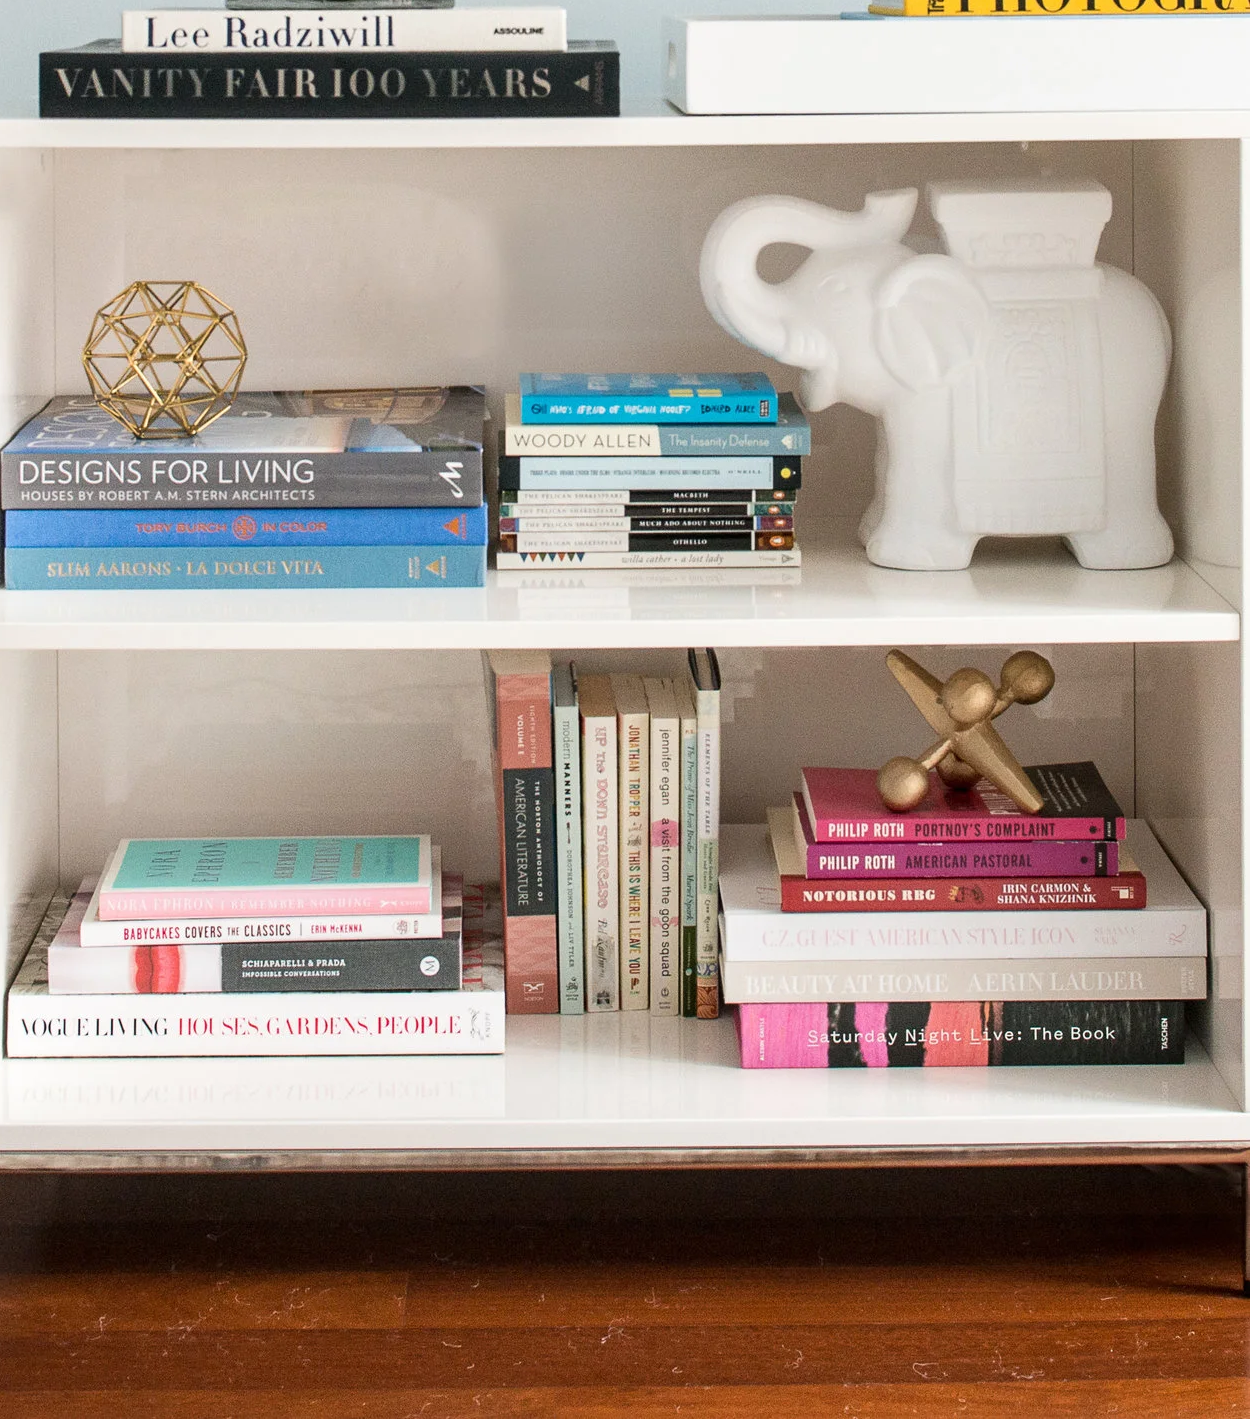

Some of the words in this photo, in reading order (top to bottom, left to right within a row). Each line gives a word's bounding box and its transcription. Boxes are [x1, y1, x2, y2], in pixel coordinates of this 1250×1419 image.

[146, 15, 210, 48] Lee
[223, 14, 396, 48] Radziwill
[493, 27, 545, 35] ASSOULINE
[54, 66, 212, 100] VANITY
[223, 67, 319, 99] FAIR
[419, 66, 552, 99] YEARS
[514, 433, 587, 448] WOODY
[593, 433, 651, 448] ALLEN
[669, 434, 688, 447] The
[691, 433, 727, 449] Insanity
[729, 434, 770, 447] Defense
[19, 459, 142, 484] DESIGNS
[152, 459, 208, 484] FOR
[218, 459, 315, 484] LIVING
[20, 490, 74, 502] HOUSES
[78, 490, 94, 501] BY
[99, 490, 150, 501] ROBERT
[155, 490, 182, 501] A.M.
[187, 490, 228, 501] STERN
[232, 489, 316, 501] ARCHITECTS
[673, 491, 709, 499] MACBETH
[135, 522, 172, 534] TORY
[176, 522, 227, 533] BURCH
[261, 521, 277, 532] IN
[278, 521, 328, 532] COLOR
[681, 519, 707, 527] ABOUT
[672, 538, 707, 546] OTHELLO
[621, 554, 643, 564] willa
[646, 554, 672, 564] cather
[689, 553, 703, 563] lost
[705, 554, 724, 565] lady
[47, 562, 90, 577] SLIM
[96, 561, 172, 576] AARONS
[186, 561, 208, 575] LA
[214, 561, 276, 575] DOLCE
[281, 560, 325, 574] VITA
[562, 721, 573, 760] modern
[628, 724, 641, 772] JONATHAN
[659, 728, 672, 773] jennifer
[564, 762, 572, 817] MANNERS
[704, 777, 711, 788] OF
[628, 778, 641, 818] TROPPER
[659, 777, 671, 806] egan
[514, 778, 527, 838] AMERICAN
[661, 817, 670, 826] a
[828, 822, 869, 838] PHILIP
[873, 822, 905, 838] ROTH
[914, 822, 983, 838] PORTNOY'S
[986, 822, 1056, 837] COMPLAINT
[661, 829, 671, 852] visit
[535, 837, 543, 888] ANTHOLOGY
[628, 850, 641, 872] THIS
[661, 856, 671, 882] from
[819, 856, 860, 870] PHILIP
[864, 855, 896, 869] ROTH
[905, 854, 968, 869] AMERICAN
[973, 854, 1033, 868] PASTORAL
[515, 842, 529, 906] LITERATURE
[628, 874, 641, 883] IS
[686, 874, 694, 897] Muriel
[1002, 883, 1028, 894] IRIN
[1030, 883, 1080, 894] CARMON
[1082, 883, 1092, 893] &
[537, 891, 544, 902] OF
[628, 886, 641, 917] WHERE
[661, 886, 671, 904] the
[802, 889, 897, 902] NOTORIOUS
[901, 889, 936, 901] RBG
[997, 894, 1036, 904] SHANA
[1039, 893, 1097, 904] KNIZHNIK
[106, 899, 148, 912] NORA
[153, 898, 214, 911] EPHRON
[231, 899, 304, 910] REMEMBER
[310, 898, 371, 909] NOTHING
[683, 899, 694, 921] Spark
[311, 924, 328, 934] ERIN
[330, 923, 363, 934] McKENNA
[659, 909, 671, 937] goon
[123, 927, 181, 940] BABYCAKES
[184, 925, 223, 939] COVERS
[227, 926, 240, 936] THE
[244, 924, 292, 937] CLASSICS
[629, 927, 641, 954] LEAVE
[762, 929, 795, 947] C.Z.
[796, 928, 859, 948] GUEST
[866, 927, 962, 946] AMERICAN
[968, 927, 1025, 946] STYLE
[1031, 926, 1077, 945] ICON
[241, 959, 305, 968] SCHIAPARELLI
[306, 959, 315, 968] &
[316, 958, 346, 968] PRADA
[629, 957, 641, 975] YOU
[659, 941, 672, 977] squad
[241, 970, 282, 978] IMPOSSIBLE
[283, 969, 340, 977] CONVERSATIONS
[746, 974, 839, 996] BEAUTY
[841, 973, 873, 994] AT
[877, 972, 949, 993] HOME
[967, 971, 1044, 993] AERIN
[1049, 970, 1147, 992] LAUDER
[20, 1017, 89, 1038] VOGUE
[95, 1016, 168, 1037] LIVING
[177, 1016, 263, 1040] HOUSES,
[269, 1016, 373, 1039] GARDENS,
[376, 1015, 462, 1036] PEOPLE
[807, 1029, 897, 1047] Saturday
[905, 1028, 962, 1047] Night
[970, 1027, 1022, 1046] Live:
[1030, 1026, 1064, 1041] The
[1071, 1025, 1116, 1041] Book
